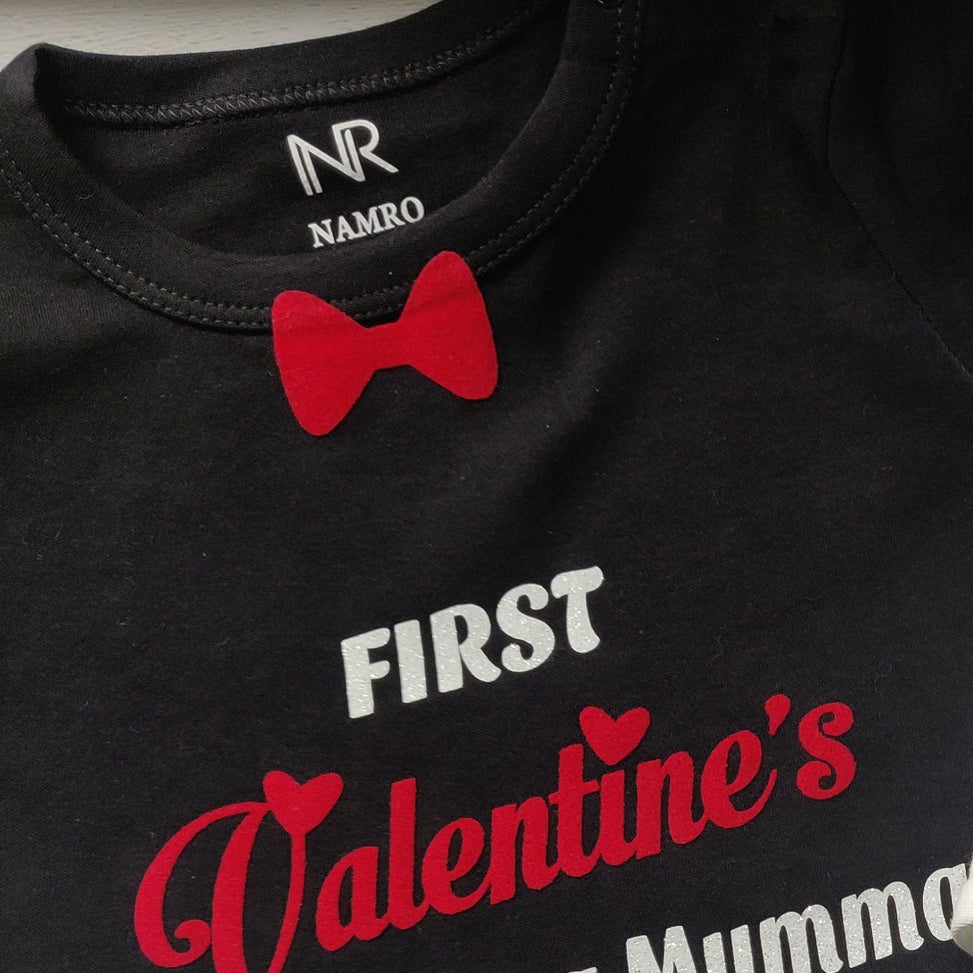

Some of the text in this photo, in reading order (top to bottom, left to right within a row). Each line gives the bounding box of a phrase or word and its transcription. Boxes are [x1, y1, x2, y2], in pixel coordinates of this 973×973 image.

[287, 119, 399, 195] NR
[308, 196, 425, 248] NAMRO
[341, 566, 605, 719] FIRST
